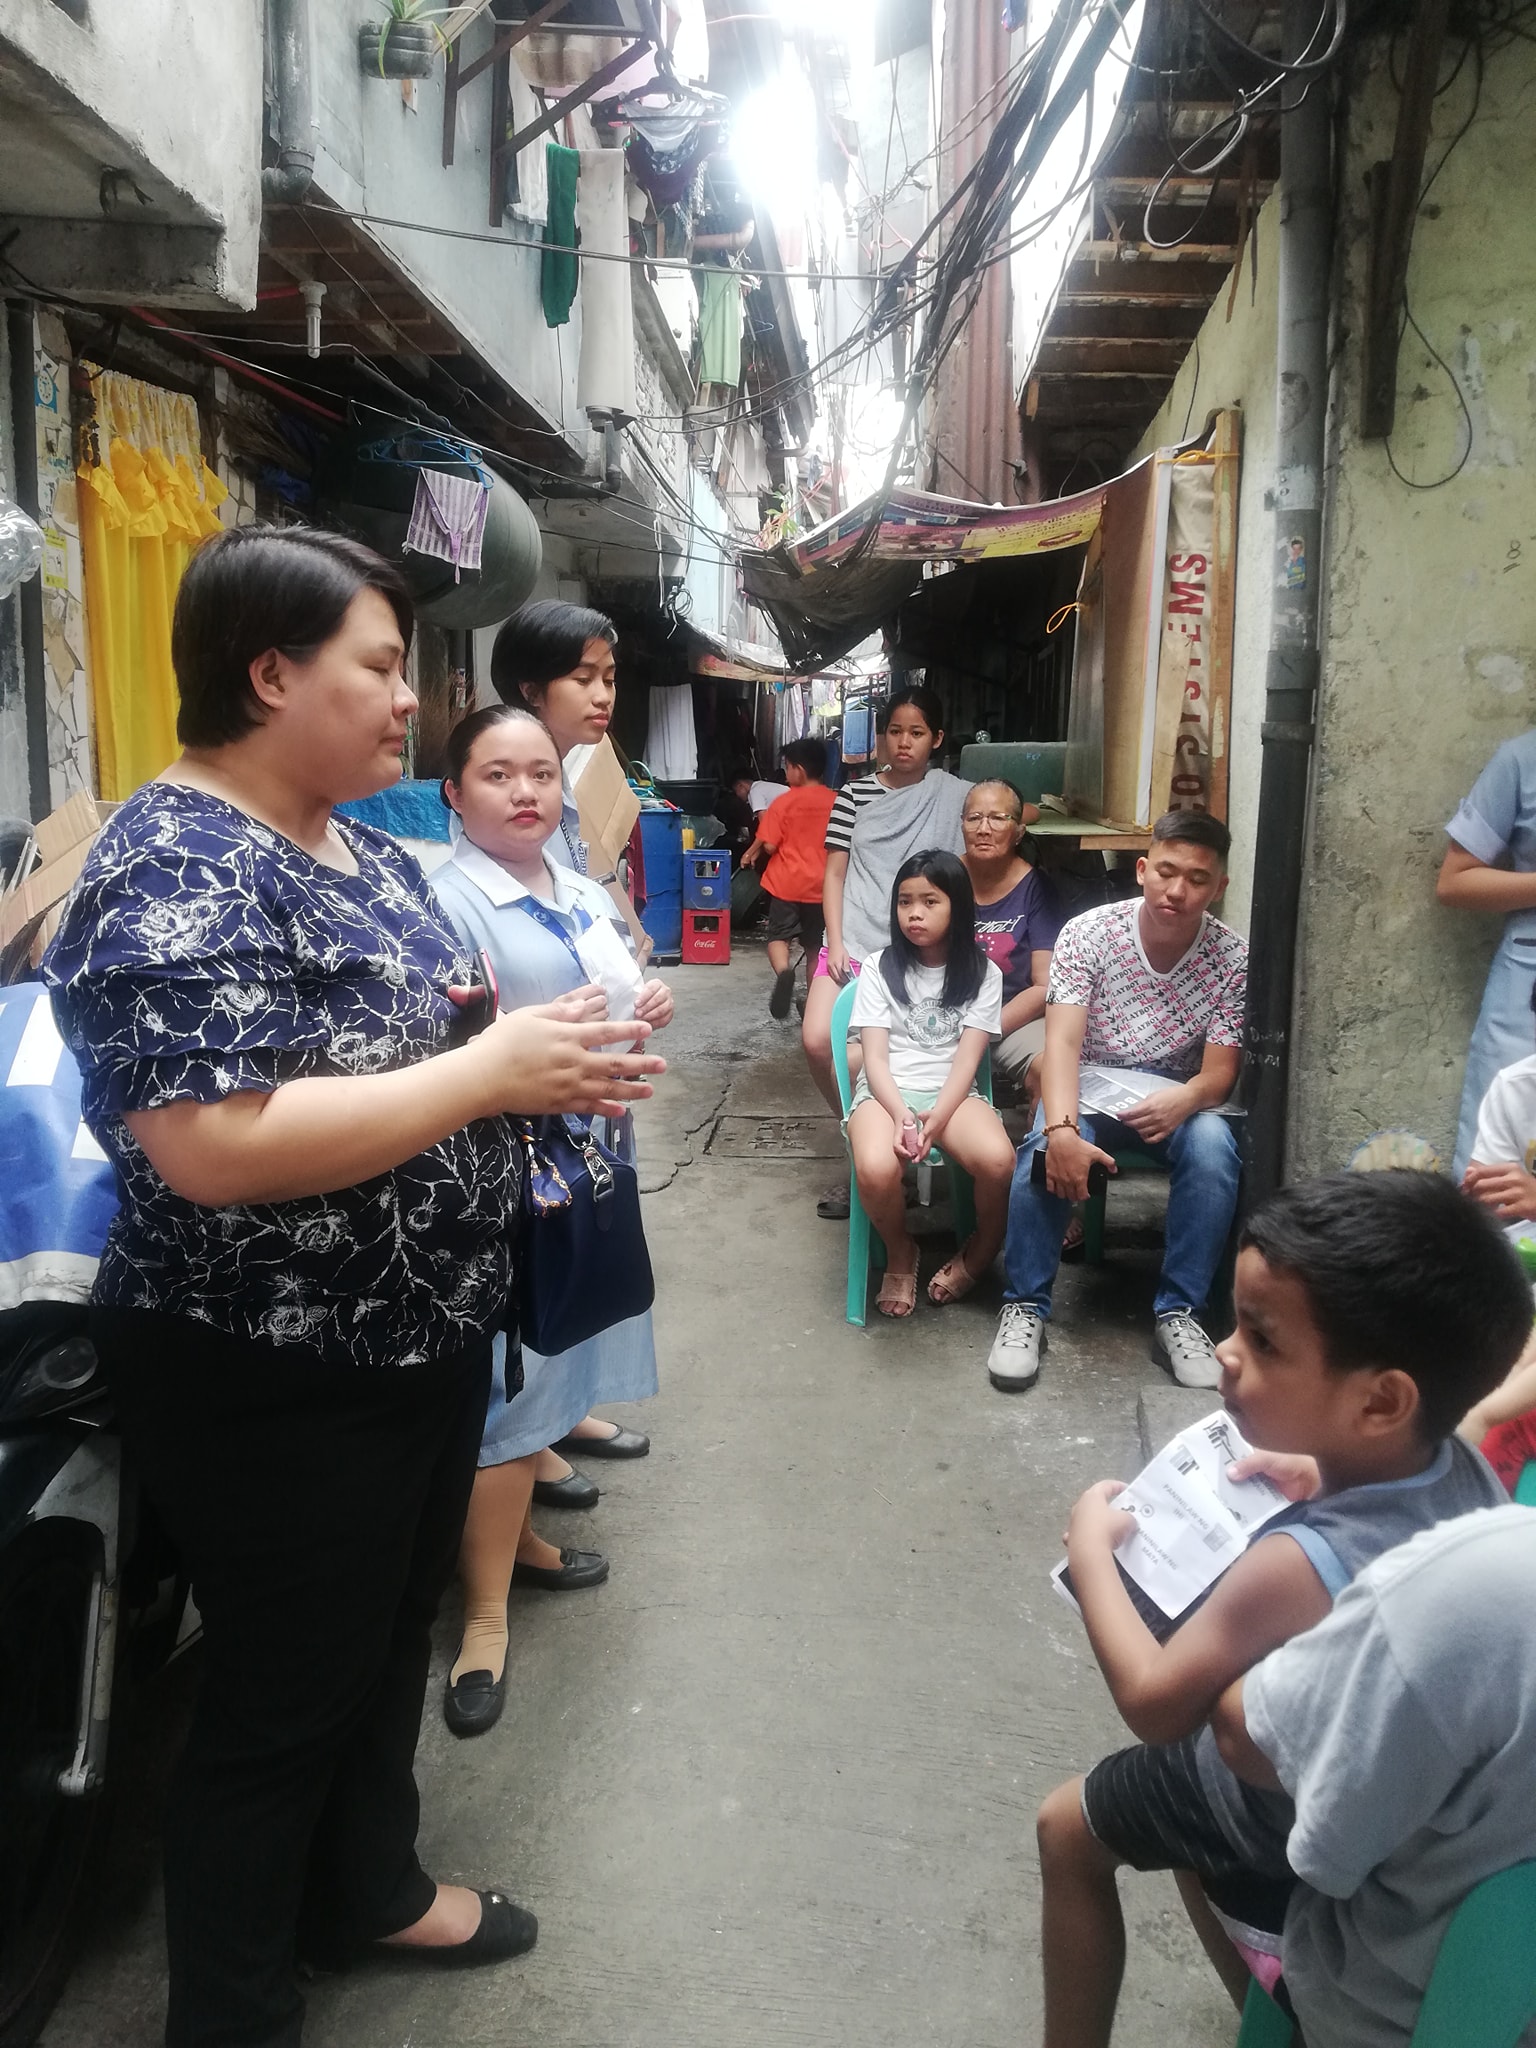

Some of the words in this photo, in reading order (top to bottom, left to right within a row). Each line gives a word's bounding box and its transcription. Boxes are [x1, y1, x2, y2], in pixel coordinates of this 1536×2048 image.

[1112, 943, 1131, 956] KISS
[1186, 955, 1204, 973] KISS
[1207, 943, 1221, 955] ME
[1120, 957, 1138, 969] KISS
[1194, 967, 1212, 983] KISS
[1216, 955, 1228, 966] ME
[1126, 969, 1145, 982] KISS
[1168, 992, 1181, 1002] ME
[1176, 979, 1207, 1005] PLAYBOY
[1201, 980, 1219, 995] KISS
[1115, 992, 1147, 1012] PLAYBOY
[1147, 1005, 1164, 1018] KISS
[1176, 1001, 1189, 1012] ME
[1183, 992, 1215, 1015] PLAYBOY
[1121, 1004, 1154, 1025] PLAYBOY
[1153, 1014, 1172, 1030] KISS
[1184, 1013, 1196, 1023] ME
[1120, 1022, 1132, 1032] ME
[1127, 1016, 1159, 1037] PLAYBOY
[1160, 1023, 1180, 1039] KISS
[1127, 1035, 1140, 1045] ME
[1135, 1026, 1167, 1049] PLAYBOY
[1142, 1035, 1175, 1058] PLAYBOY
[1168, 1035, 1187, 1050] KISS
[1163, 1483, 1199, 1519] PANINILAW
[1198, 1518, 1210, 1530] NG
[1136, 1527, 1169, 1560] ANINILAW
[1167, 1558, 1178, 1571] NG
[1142, 1546, 1159, 1566] MATA
